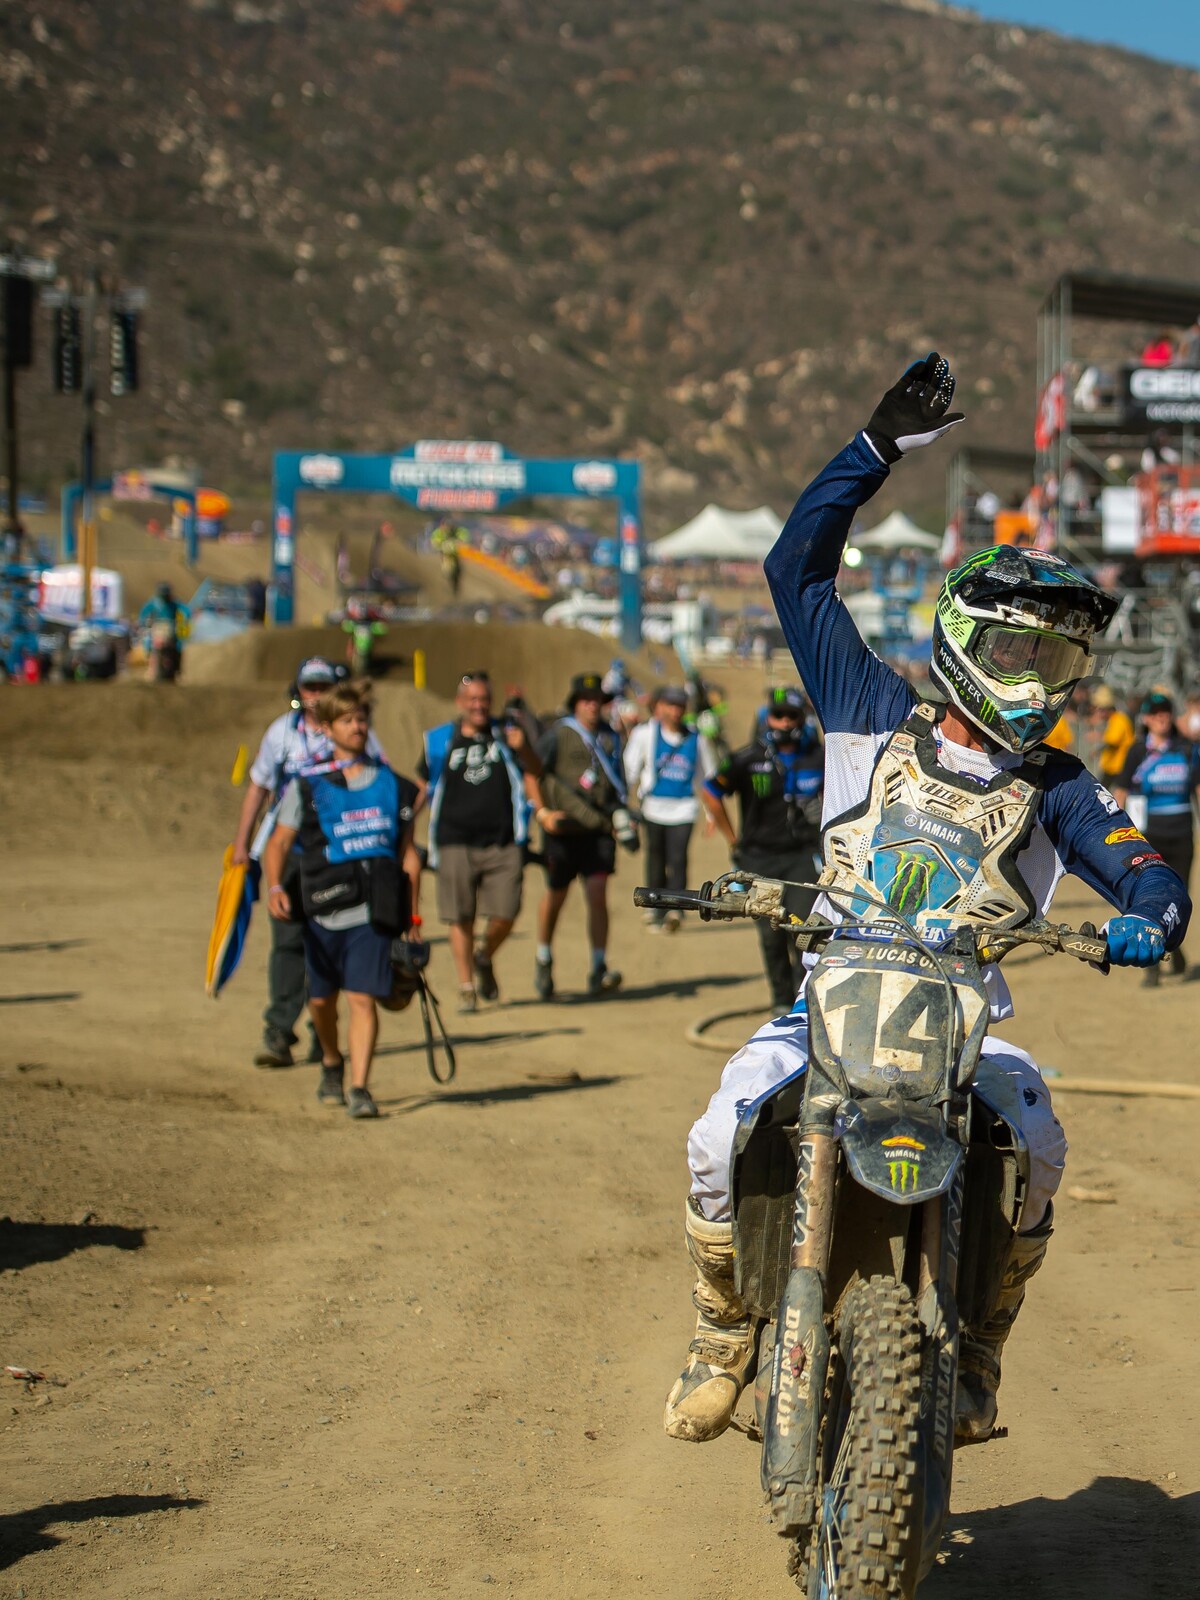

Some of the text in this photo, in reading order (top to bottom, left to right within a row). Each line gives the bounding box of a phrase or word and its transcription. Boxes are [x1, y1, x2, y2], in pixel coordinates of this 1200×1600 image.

[940, 647, 982, 703] MONSTER
[941, 664, 971, 701] ENERGY
[925, 805, 953, 819] OGIO
[918, 818, 962, 845] YAMAHA
[866, 947, 917, 965] LUCAS
[1066, 941, 1104, 956] ARC
[824, 971, 962, 1076] 14
[884, 1149, 921, 1161] YAMAHA
[776, 1305, 800, 1437] DUNLOP
